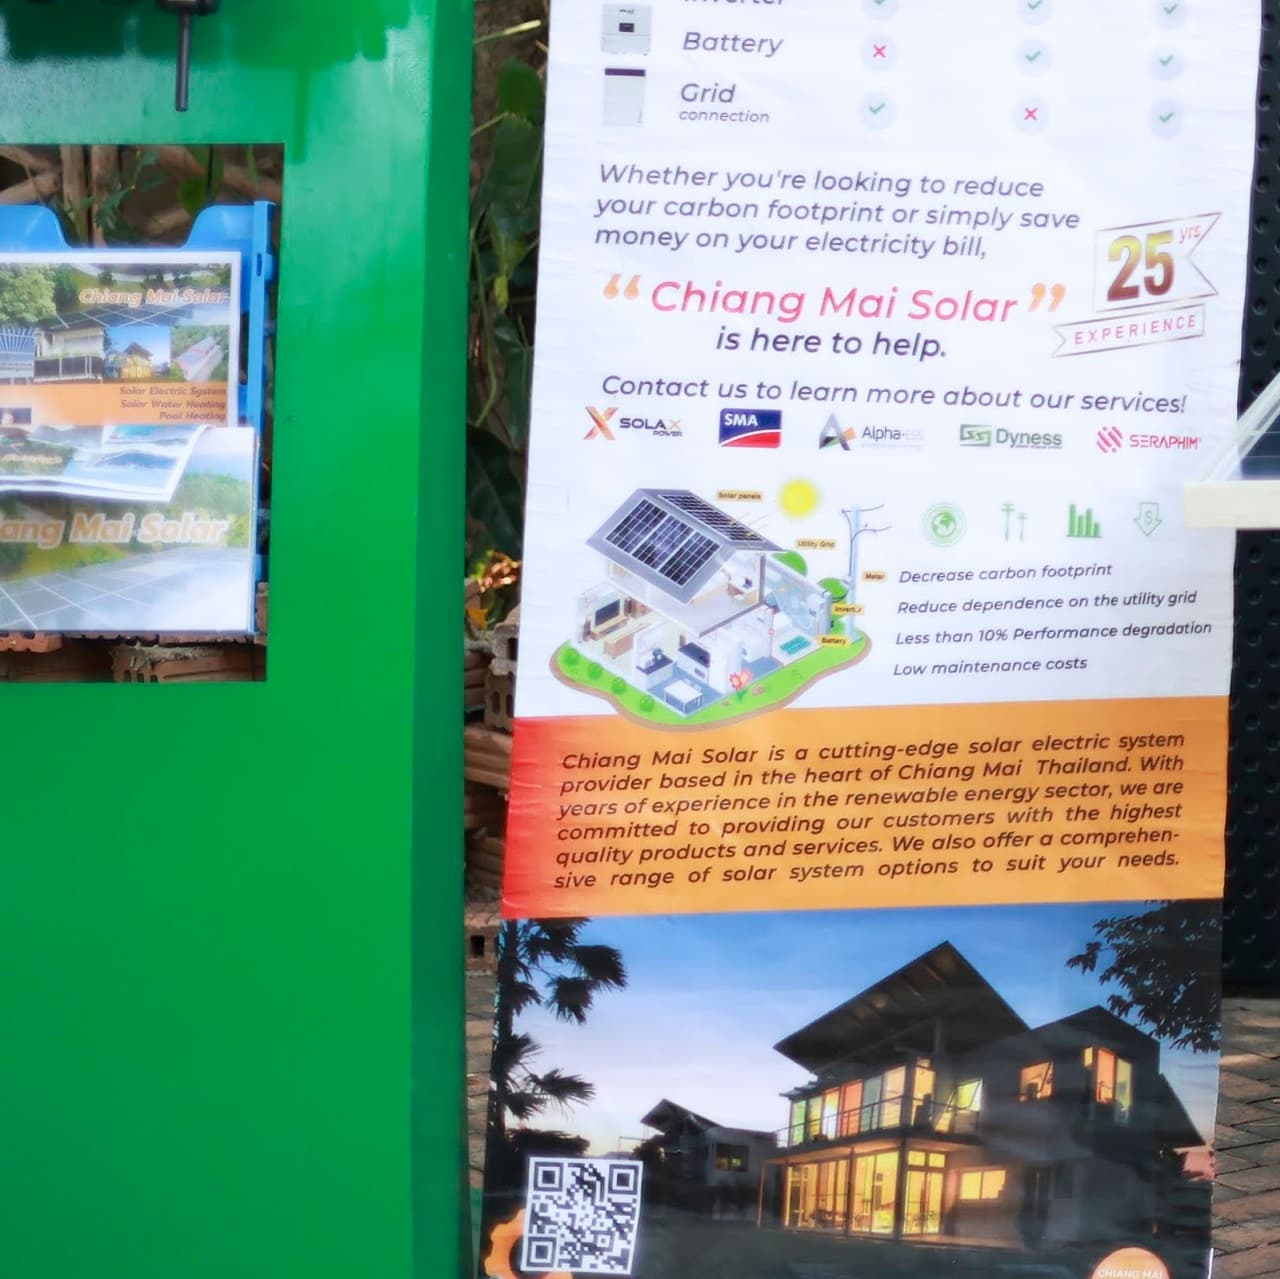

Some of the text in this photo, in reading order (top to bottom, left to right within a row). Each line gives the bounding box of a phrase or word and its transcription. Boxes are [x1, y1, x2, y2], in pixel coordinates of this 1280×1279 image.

[682, 31, 785, 59] Battery
[680, 82, 737, 104] Grid
[678, 109, 771, 124] connection
[600, 163, 1045, 199] Whether you're looking to reduce
[592, 196, 1081, 232] your carbon footprint or simply save
[594, 228, 986, 260] money on your electricity bill,
[1106, 224, 1202, 302] 25 yrs
[79, 287, 228, 308] Chiang Mai Solar
[651, 279, 1019, 324] Chiang Mai Solar
[715, 324, 946, 363] is here to help.
[1073, 314, 1197, 346] EXPERIENCE
[119, 385, 146, 396] Solar
[149, 385, 187, 396] Electric
[151, 399, 182, 409] Water
[185, 399, 227, 411] Heating
[601, 374, 1188, 414] Contact us to learn more about our services!
[724, 413, 759, 427] SMA
[995, 427, 1063, 448] Dyness
[1129, 434, 1199, 450] SERAPHIM
[69, 510, 230, 544] Mai Solar
[898, 562, 1114, 584] Decrease carbon footprint
[897, 589, 1198, 615] Reduce dependence on the utility grid
[895, 620, 1213, 646] Less than 10% Performance degradation
[892, 656, 1089, 677] Low maintenance costs
[561, 732, 1185, 771] Chiang Mai Solar is cutting-edge solar electric system
[559, 753, 1185, 797] provider based the heart Chiang Mai Thailand. With
[555, 781, 1185, 822] years experience the renewable energy sector, we are
[556, 802, 1183, 842] committed providing our customers with the highest
[555, 826, 1180, 869] quality products and services. We also offer comprehen-
[552, 849, 1180, 889] sive range solar system options suit your needs.
